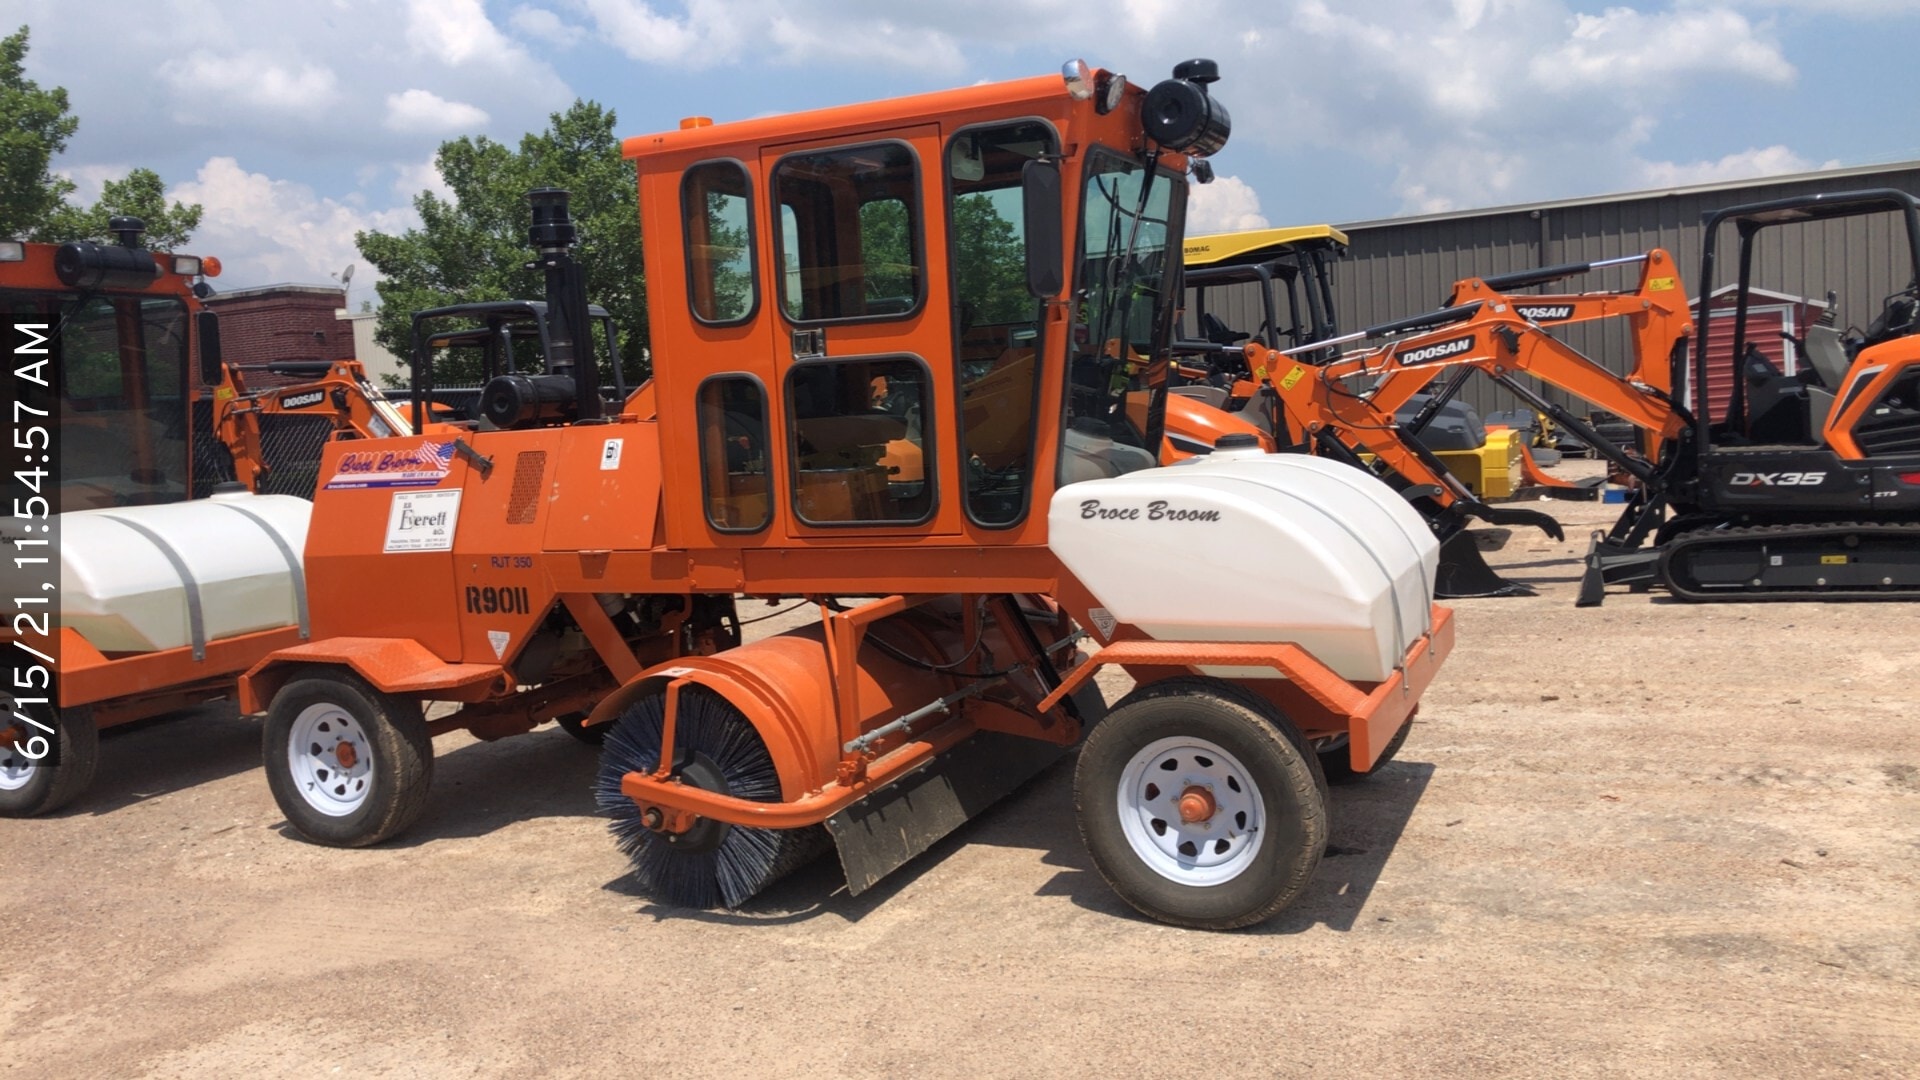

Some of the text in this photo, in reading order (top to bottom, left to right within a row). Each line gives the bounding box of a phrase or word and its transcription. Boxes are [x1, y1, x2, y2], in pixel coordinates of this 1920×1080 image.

[1184, 245, 1210, 253] BOMAG
[1402, 338, 1470, 365] DOOSAN
[283, 392, 323, 408] DOOSAN
[1729, 472, 1828, 486] DX35
[1080, 499, 1221, 522] Broce Broom
[491, 556, 533, 568] RJT 350
